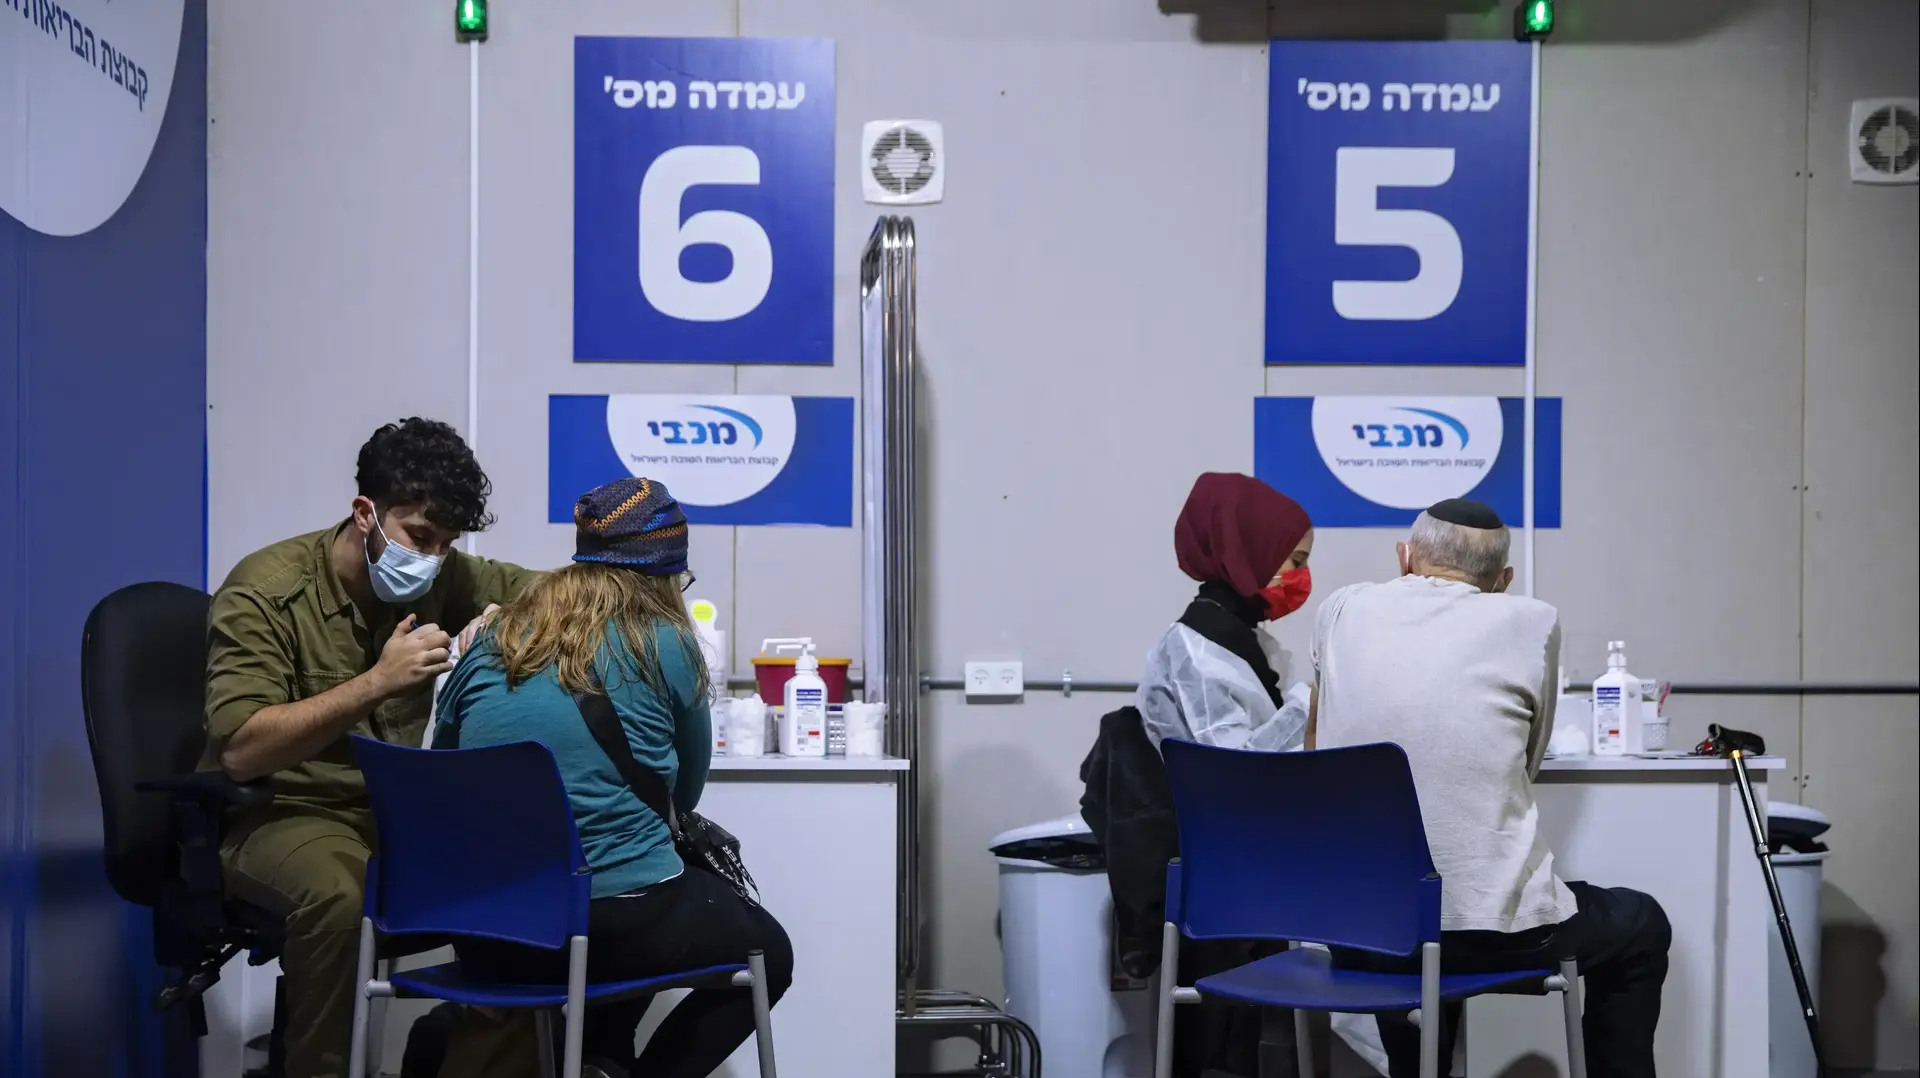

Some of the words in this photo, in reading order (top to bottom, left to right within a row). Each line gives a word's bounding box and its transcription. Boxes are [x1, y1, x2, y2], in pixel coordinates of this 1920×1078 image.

[100, 38, 148, 112] קבוצת
[689, 80, 806, 110] עמדה
[1382, 82, 1501, 112] עמדה
[638, 145, 774, 322] 6
[1332, 145, 1464, 321] 5
[646, 420, 739, 446] מכבי
[1351, 423, 1445, 448] מכבי
